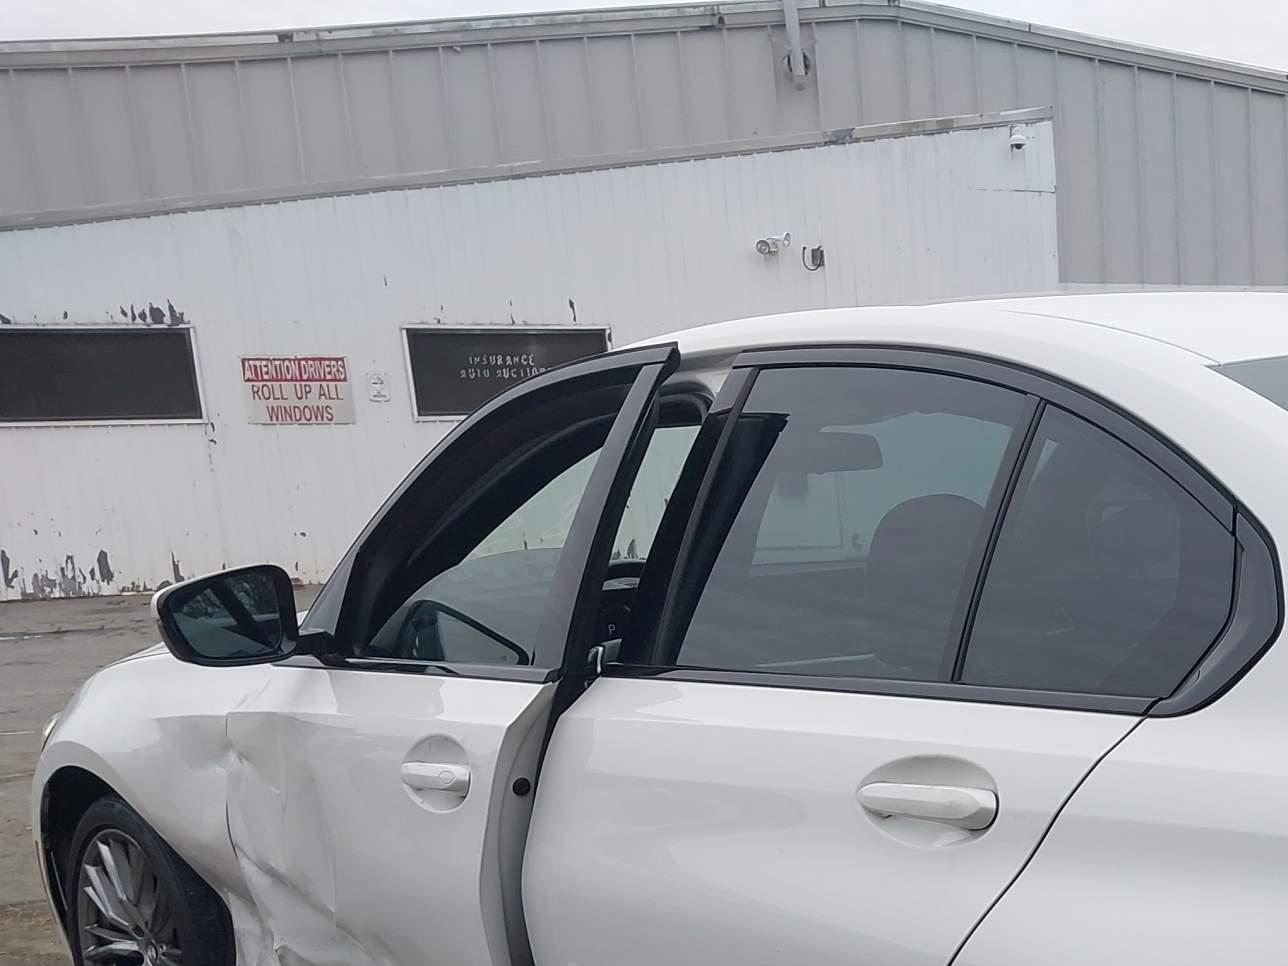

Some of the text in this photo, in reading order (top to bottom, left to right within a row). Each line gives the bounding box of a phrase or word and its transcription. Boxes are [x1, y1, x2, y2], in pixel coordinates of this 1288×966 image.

[467, 354, 535, 366] INSURANCE
[245, 359, 345, 381] ATTENTION DRIVERS
[251, 383, 345, 401] ROLL UP ALL
[266, 404, 335, 422] WINDOWS
